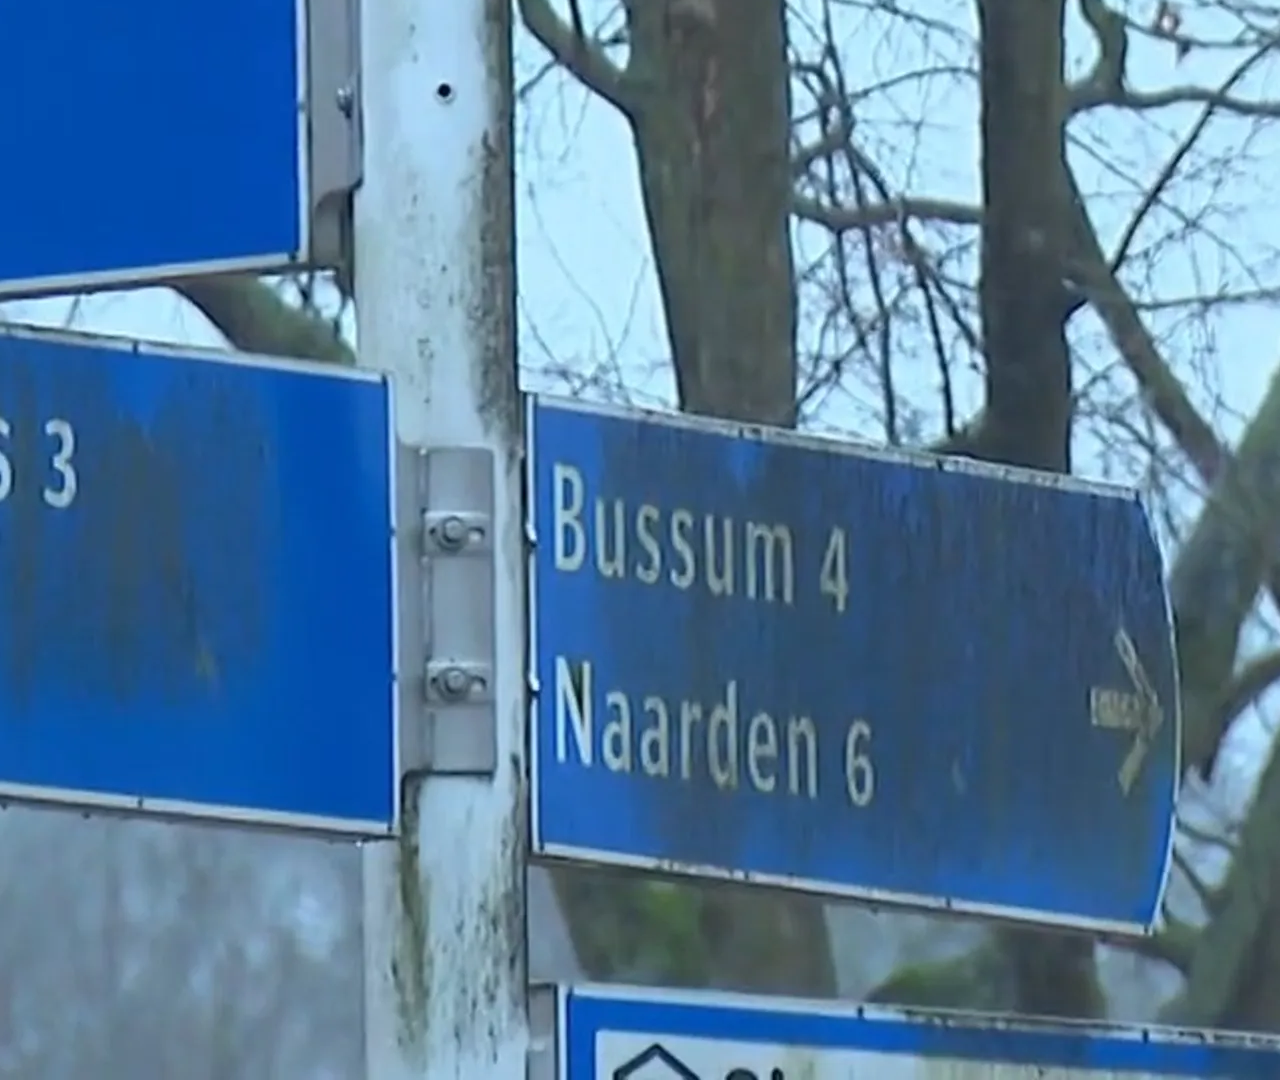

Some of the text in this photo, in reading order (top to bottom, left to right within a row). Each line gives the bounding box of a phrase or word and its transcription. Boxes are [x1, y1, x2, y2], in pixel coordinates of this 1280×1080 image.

[43, 418, 78, 508] 3
[553, 462, 849, 612] Bussum 4
[555, 655, 874, 806] Naarden 6
